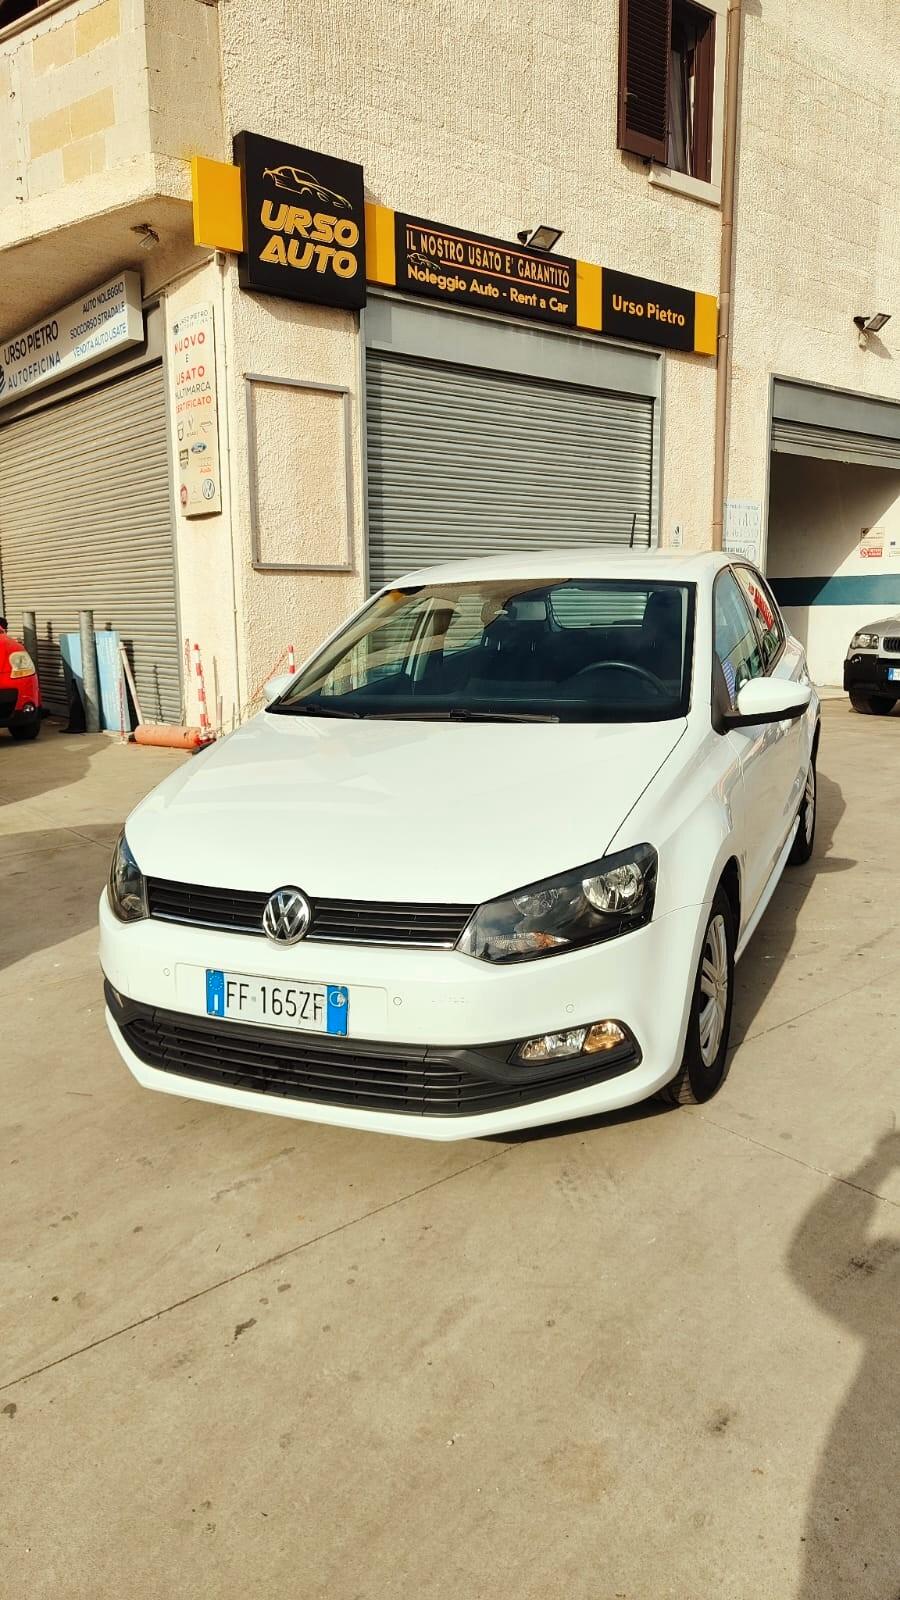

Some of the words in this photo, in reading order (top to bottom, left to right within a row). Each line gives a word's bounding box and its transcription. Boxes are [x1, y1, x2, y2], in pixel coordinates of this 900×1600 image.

[260, 199, 359, 248] URSO
[259, 235, 358, 279] AUTO
[406, 230, 417, 251] IL
[420, 233, 464, 263] NOSTRO
[468, 245, 501, 271] USATO
[518, 258, 570, 288] GARANTITO
[82, 298, 97, 314] AUTO
[96, 281, 124, 306] NOLEGGIO
[407, 263, 467, 292] Noleggio
[469, 278, 500, 298] Auto
[510, 287, 538, 306] Rent
[540, 298, 546, 309] a
[549, 297, 569, 313] Car
[69, 316, 97, 340] SOCCORSO
[97, 301, 125, 325] STRADALE
[612, 294, 644, 317] Urso
[647, 302, 685, 326] Pietro
[4, 337, 27, 366] URSO
[27, 320, 59, 354] PIETRO
[174, 331, 206, 353] NUOVO
[8, 351, 61, 390] AUTOFFICINA
[176, 365, 206, 386] USATO
[226, 980, 250, 1011] FF
[260, 985, 326, 1021] 165ZF
